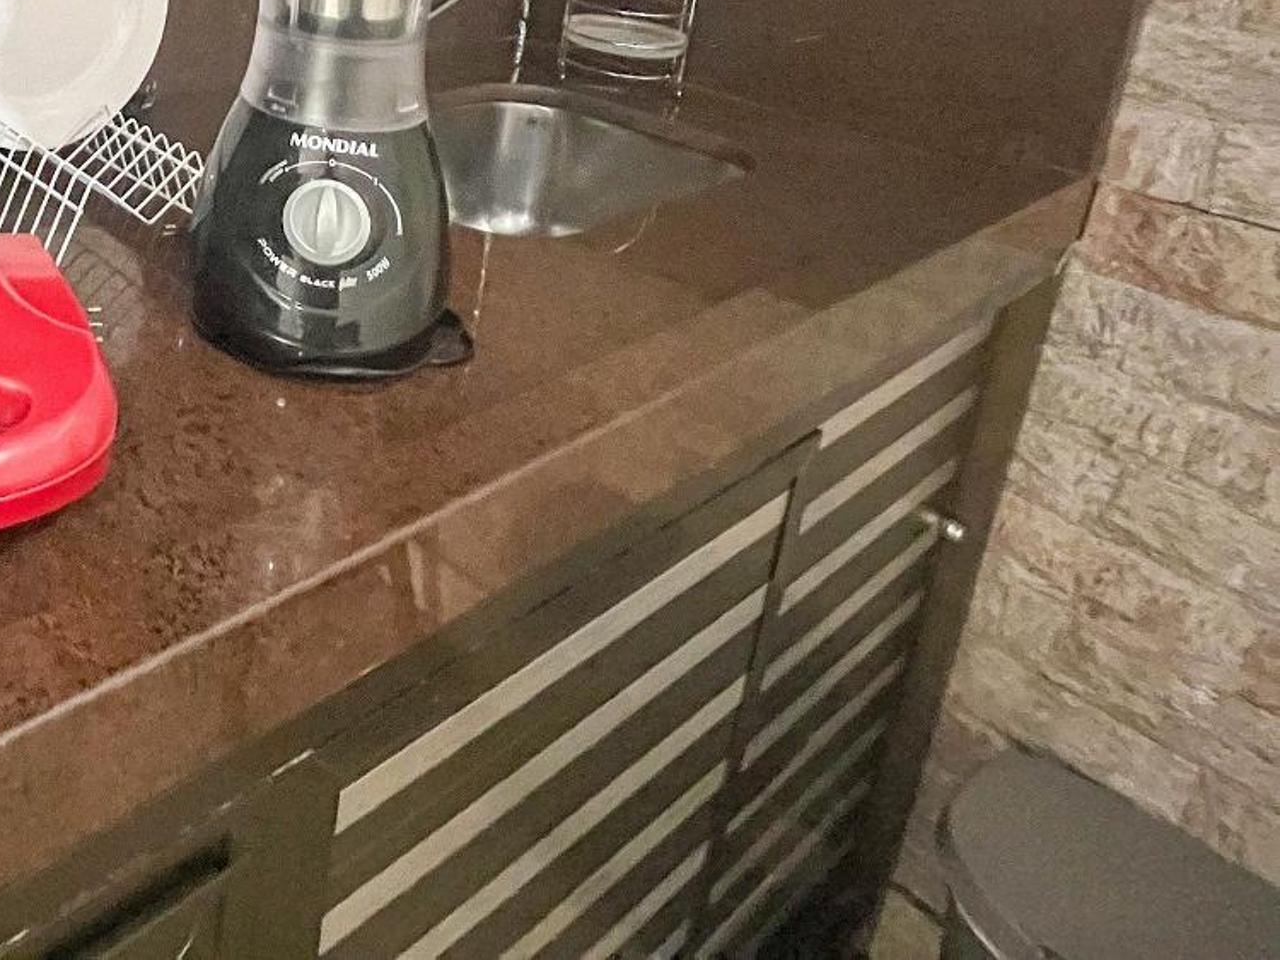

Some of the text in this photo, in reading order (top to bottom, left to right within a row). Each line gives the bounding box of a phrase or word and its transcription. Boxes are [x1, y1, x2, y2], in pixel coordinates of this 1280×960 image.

[289, 132, 380, 158] MONDIAL
[257, 238, 298, 279] POWER
[299, 274, 336, 289] BLACK
